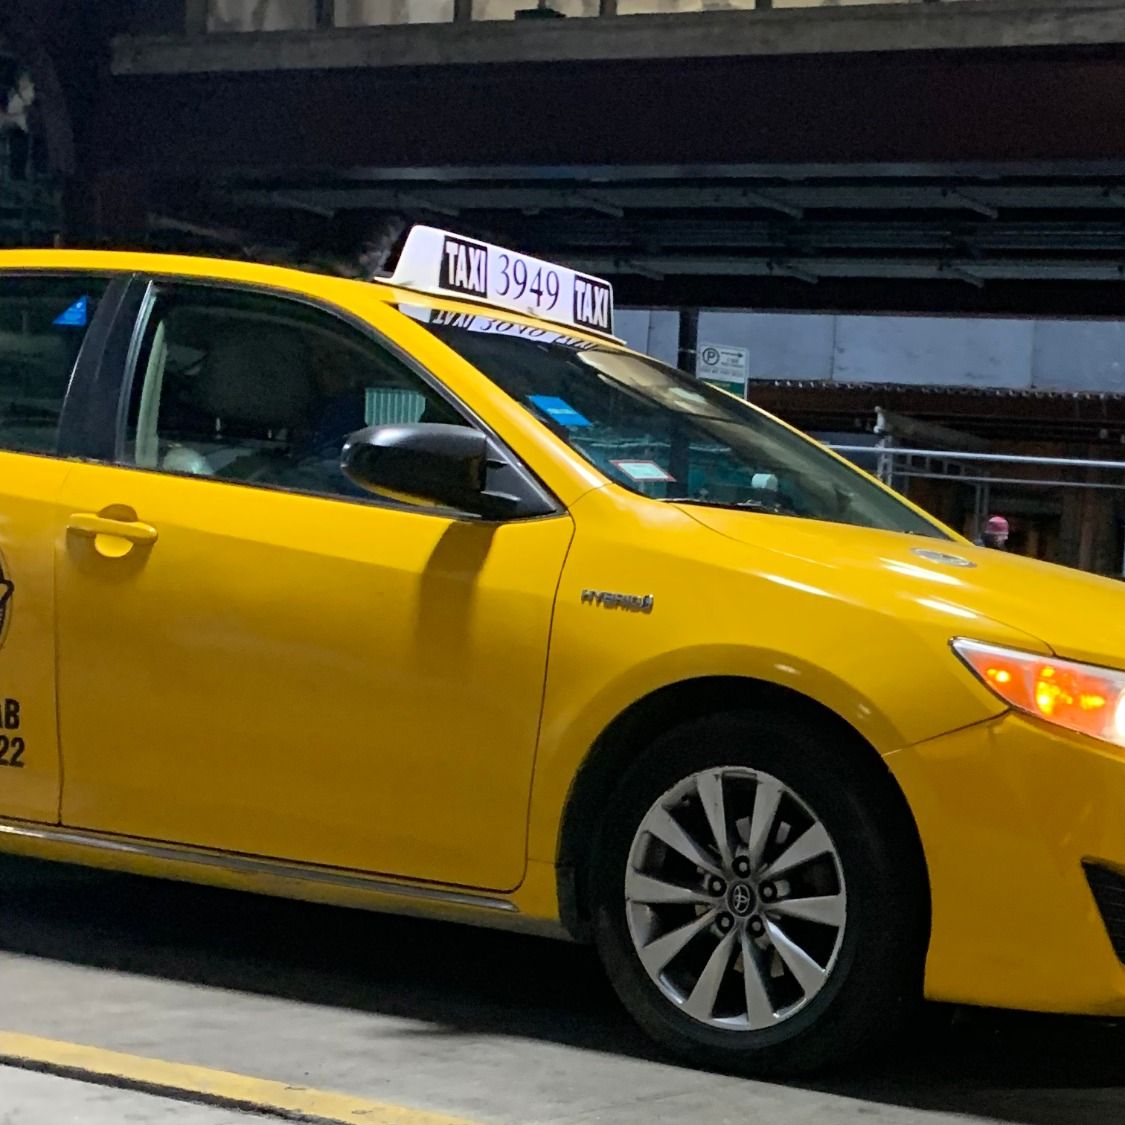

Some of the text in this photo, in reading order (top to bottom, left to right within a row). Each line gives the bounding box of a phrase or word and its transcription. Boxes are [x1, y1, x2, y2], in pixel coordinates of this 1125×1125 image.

[445, 241, 487, 294] TAXI
[496, 254, 560, 311] 3949
[573, 279, 609, 329] TAXI
